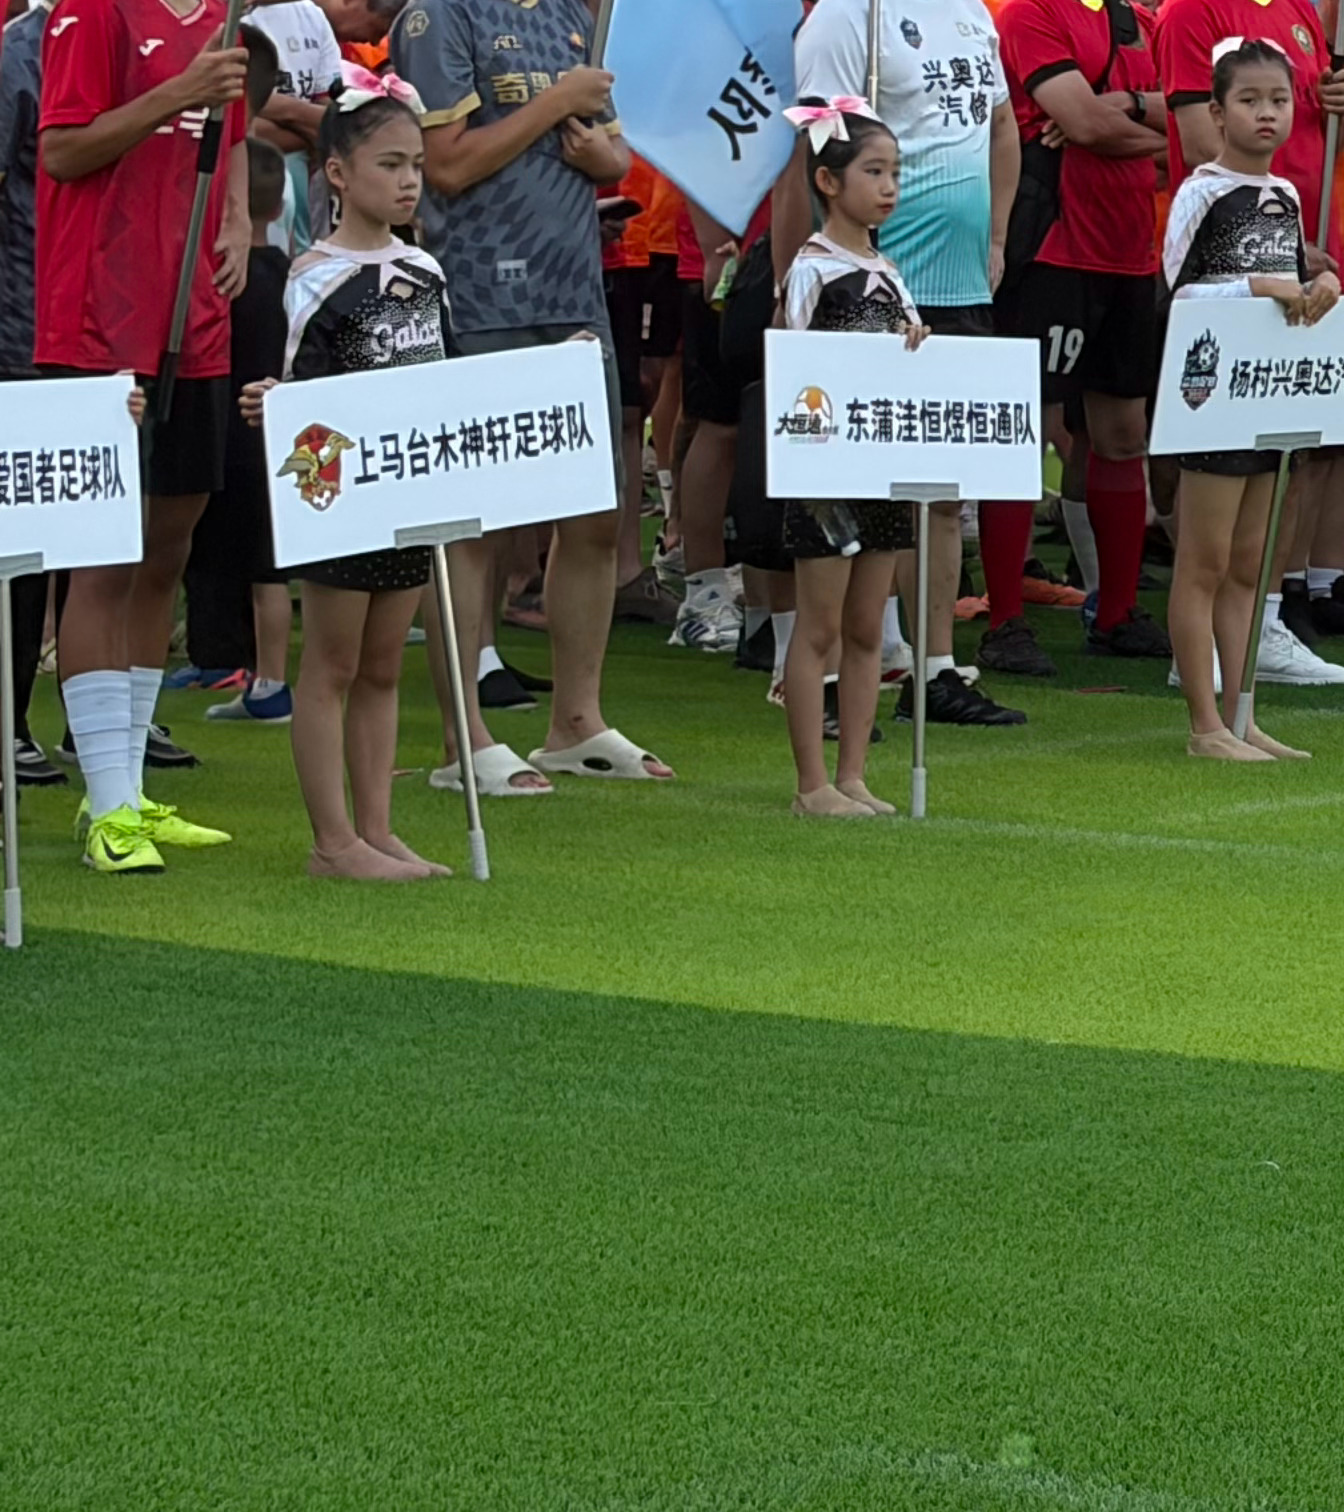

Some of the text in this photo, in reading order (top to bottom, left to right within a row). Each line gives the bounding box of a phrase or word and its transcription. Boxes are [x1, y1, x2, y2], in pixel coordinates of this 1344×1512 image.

[921, 56, 995, 93] 兴奥达
[1047, 325, 1084, 375] 19
[354, 401, 595, 486] 上马台木神轩足球队
[846, 397, 1036, 445] 东蒲洼恒煜恒通队
